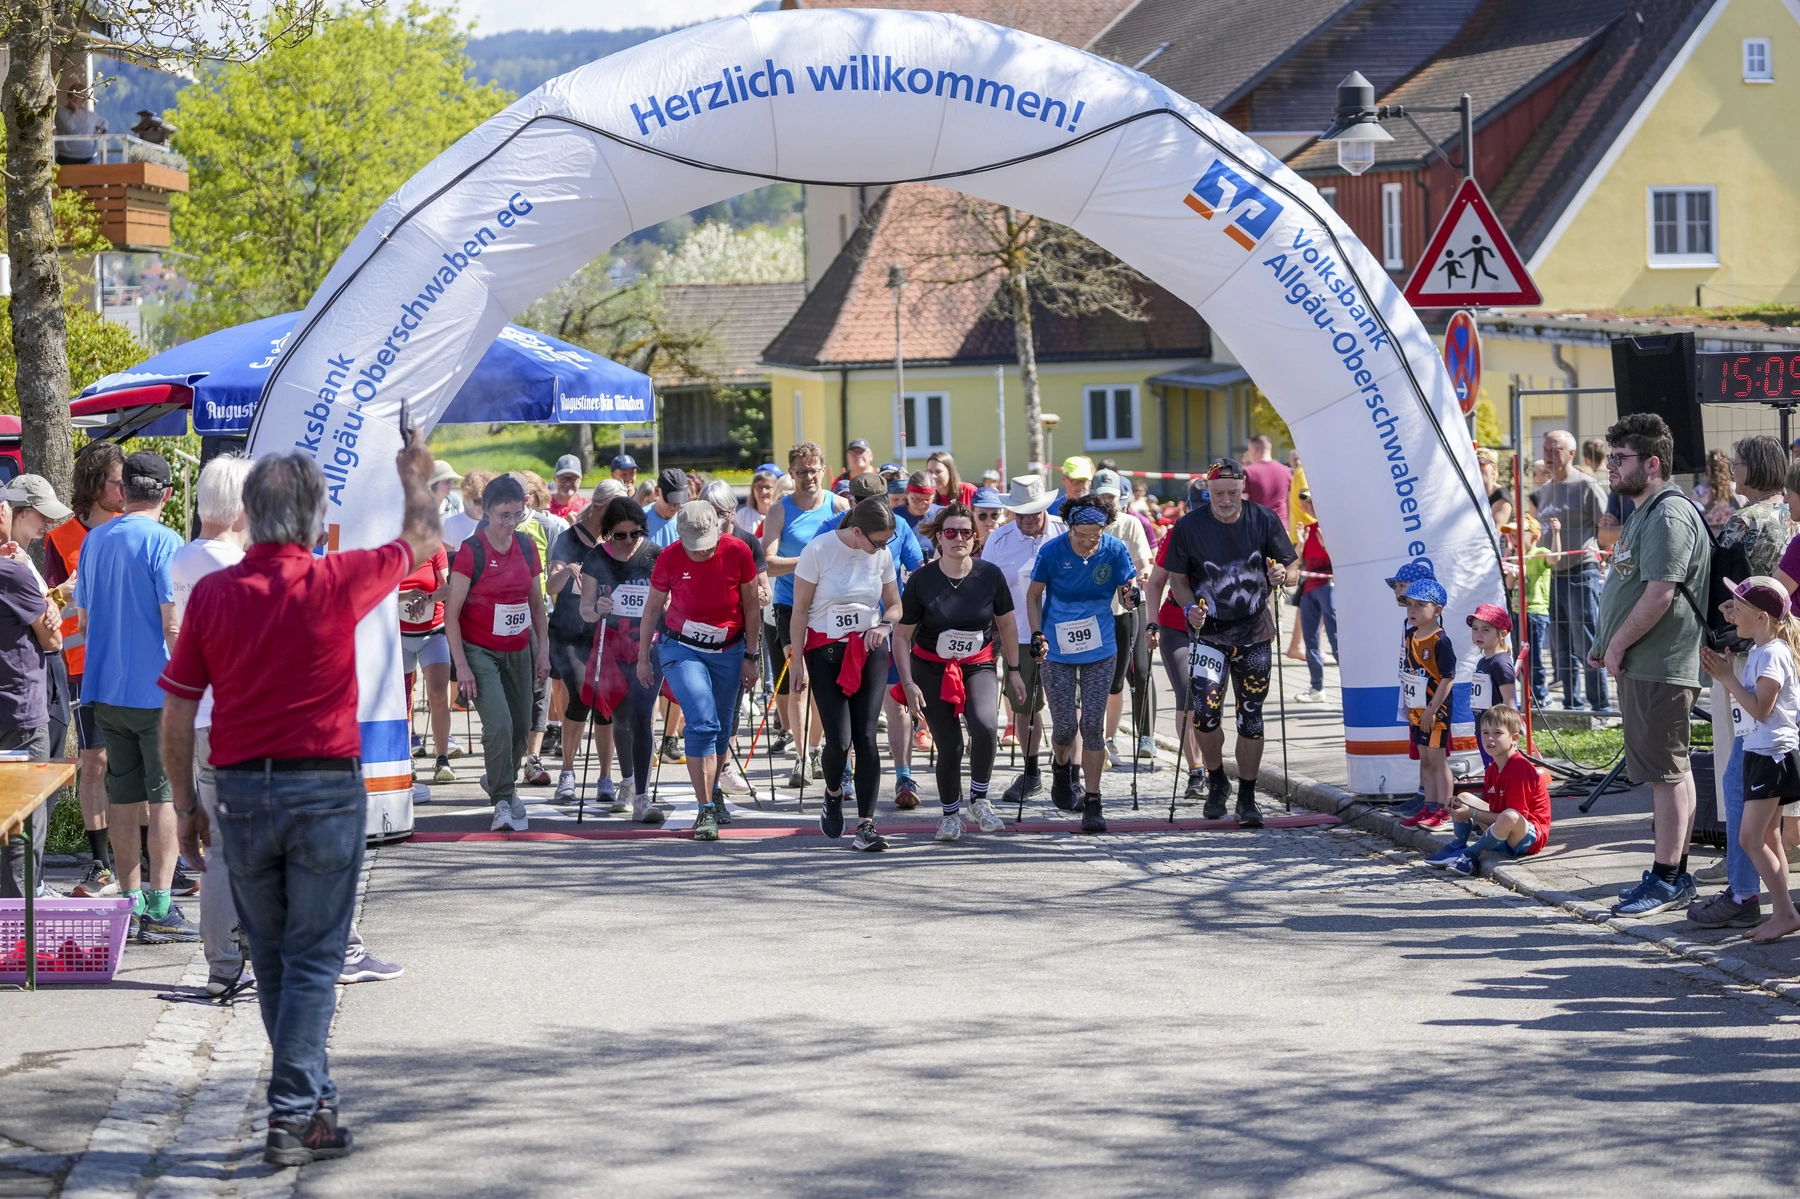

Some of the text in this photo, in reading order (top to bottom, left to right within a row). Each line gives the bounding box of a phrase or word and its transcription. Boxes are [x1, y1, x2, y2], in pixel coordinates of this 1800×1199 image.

[630, 55, 1086, 136] Herzlich willkommen!
[1292, 227, 1389, 352] Volksbank
[323, 191, 534, 507] Allgäu-Oberschwaben eG
[1263, 253, 1422, 533] Allgäu-Oberschwaben
[295, 352, 356, 460] ksbank
[621, 594, 644, 607] 365
[505, 612, 526, 626] 369
[836, 612, 859, 627] 361
[691, 631, 716, 644] 371
[1067, 628, 1092, 643] 399
[948, 639, 973, 652] 354
[1732, 708, 1742, 724] 9
